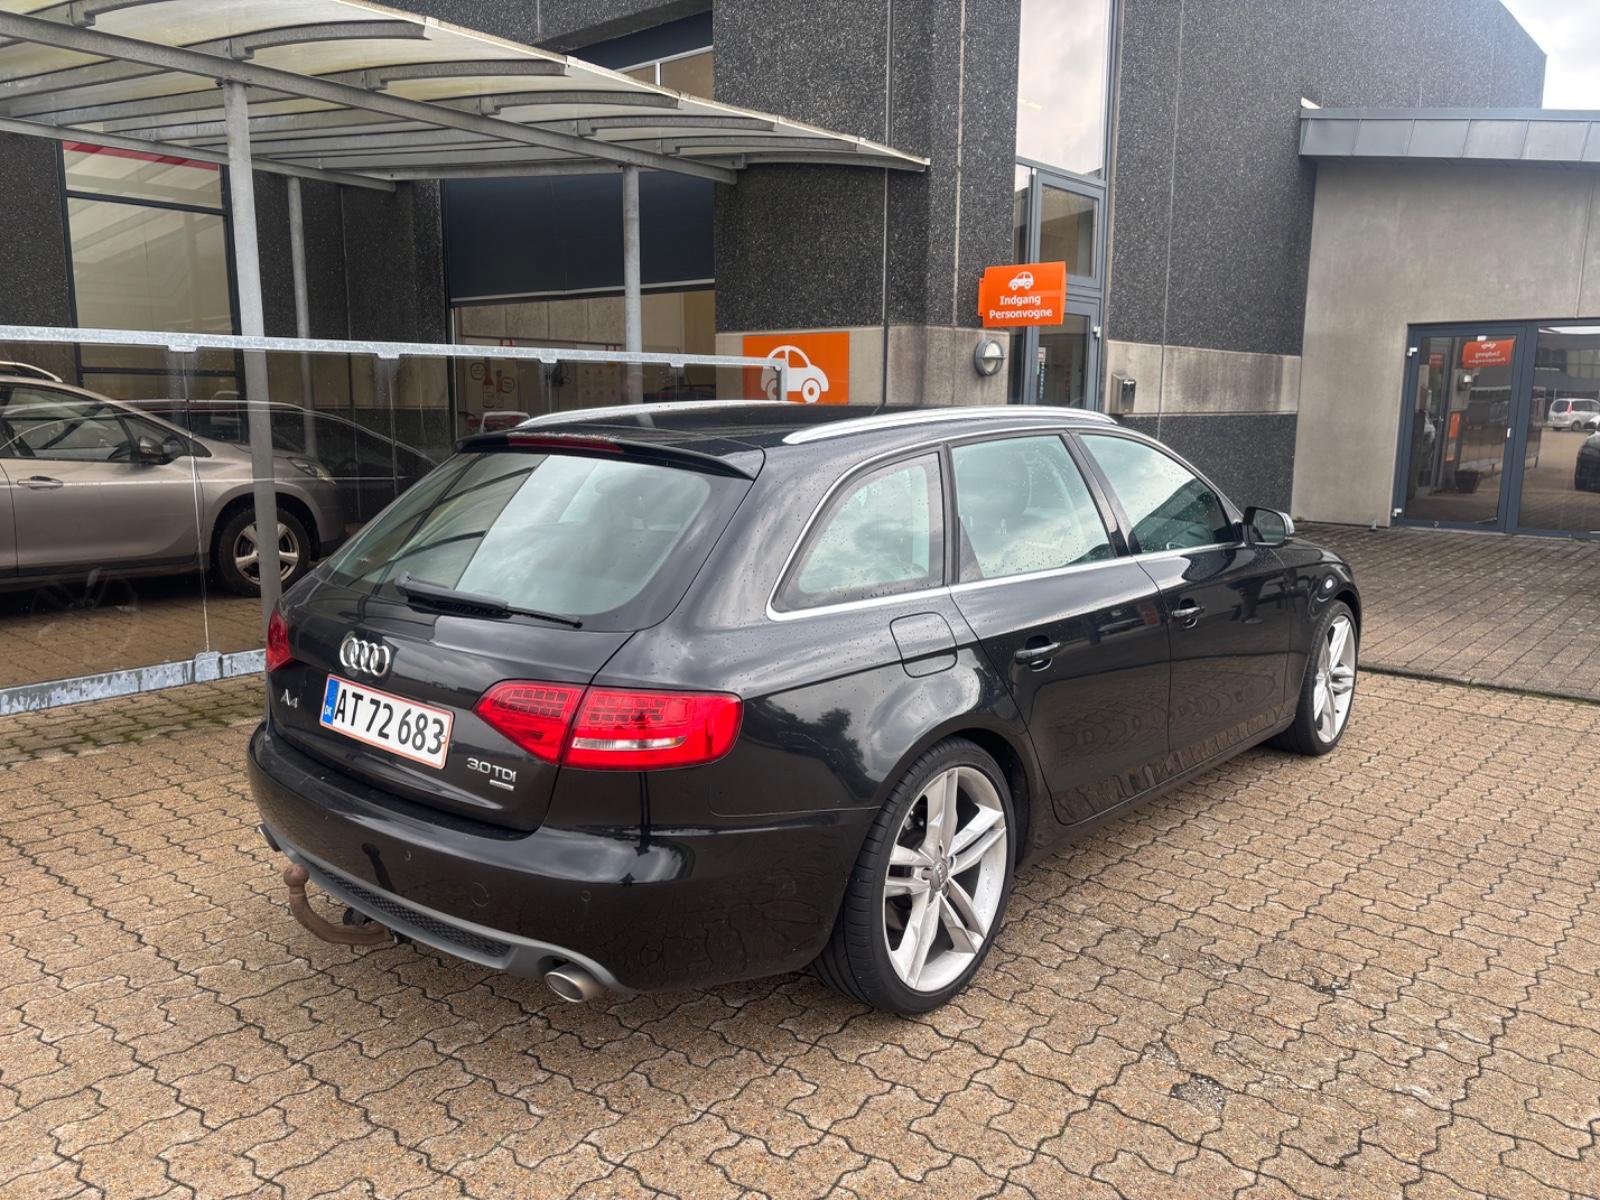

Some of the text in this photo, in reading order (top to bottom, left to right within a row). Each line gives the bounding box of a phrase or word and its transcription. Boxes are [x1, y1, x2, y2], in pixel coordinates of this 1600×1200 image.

[1000, 295, 1041, 307] Indgang
[989, 308, 1053, 320] Personvogne
[280, 688, 299, 708] A4
[334, 689, 445, 755] AT 72 683
[492, 765, 517, 783] TDI
